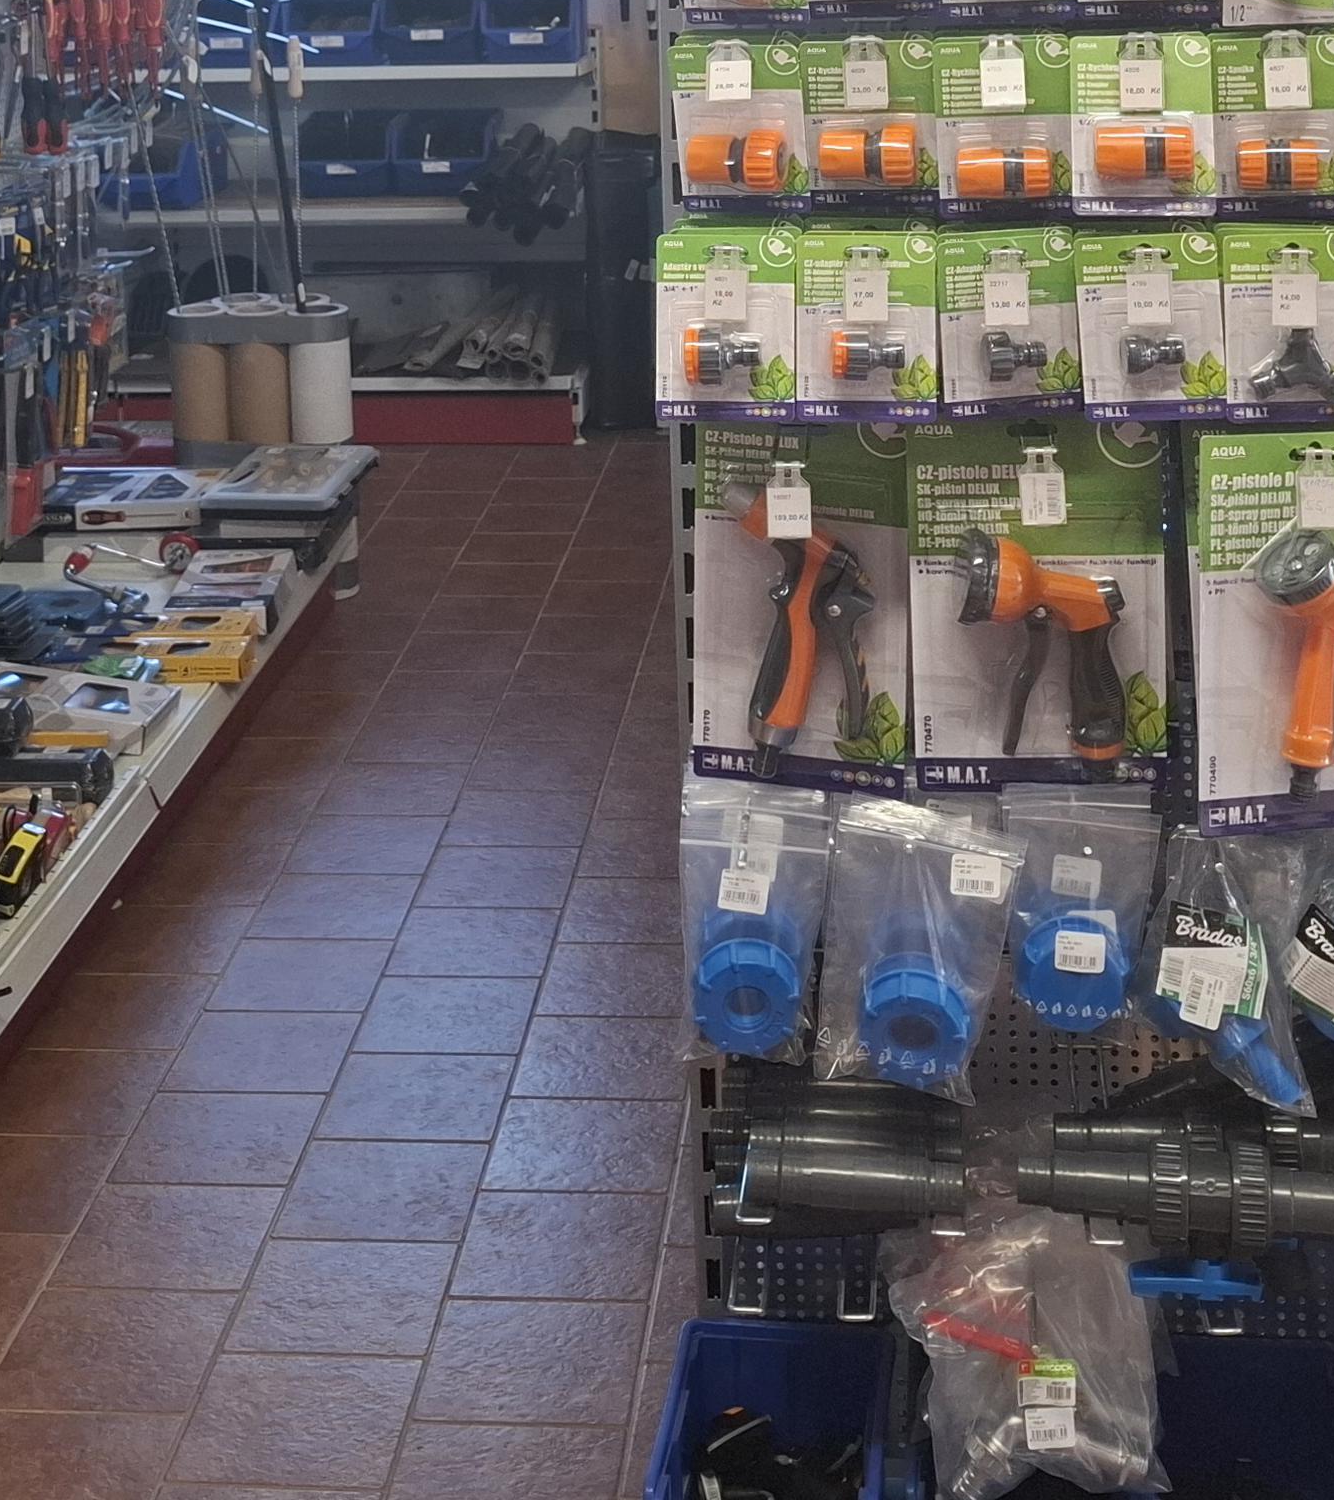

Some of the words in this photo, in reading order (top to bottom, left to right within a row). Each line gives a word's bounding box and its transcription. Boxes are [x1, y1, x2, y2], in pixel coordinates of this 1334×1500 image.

[704, 430, 765, 447] CZ-Pistole
[914, 424, 954, 437] AQUA
[1210, 445, 1246, 458] AQUA
[916, 464, 989, 482] CZ-pistole
[1210, 473, 1282, 490] CZ-pistole
[703, 709, 712, 742] 770170
[924, 715, 933, 752] 770470
[946, 765, 992, 784] M.A.T.
[1208, 756, 1217, 795] 770490
[1229, 806, 1269, 826] M.A.T.
[1176, 913, 1244, 950] Bradas
